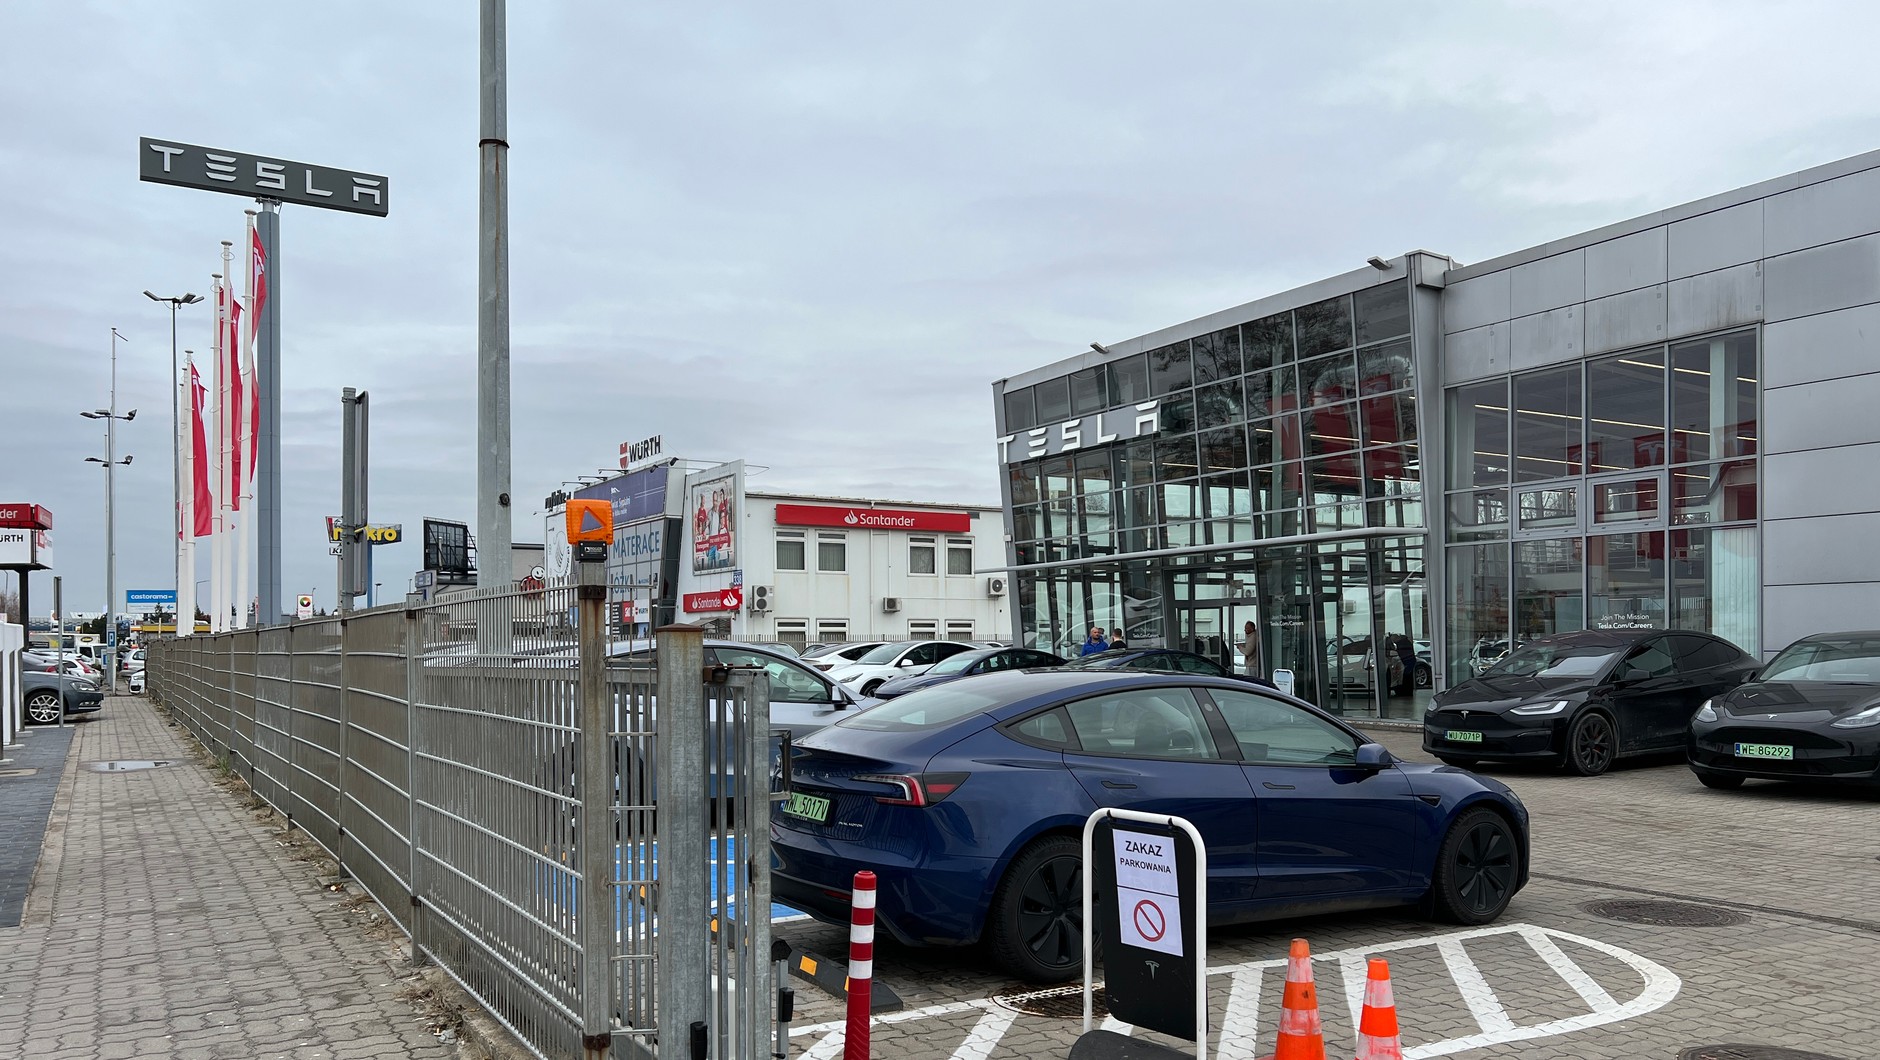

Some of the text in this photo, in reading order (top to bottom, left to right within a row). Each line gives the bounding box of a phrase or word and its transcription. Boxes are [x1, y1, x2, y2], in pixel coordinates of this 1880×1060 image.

[149, 144, 381, 205] TESLA
[997, 400, 1158, 464] TESLA
[629, 434, 661, 463] WÜRTH
[860, 513, 915, 527] Santander
[613, 531, 660, 559] MATERACE
[698, 597, 721, 608] Santande
[1741, 745, 1790, 757] WE 8G292
[1125, 840, 1163, 857] ZAKAZ
[1120, 857, 1172, 874] PARKOWANIA
